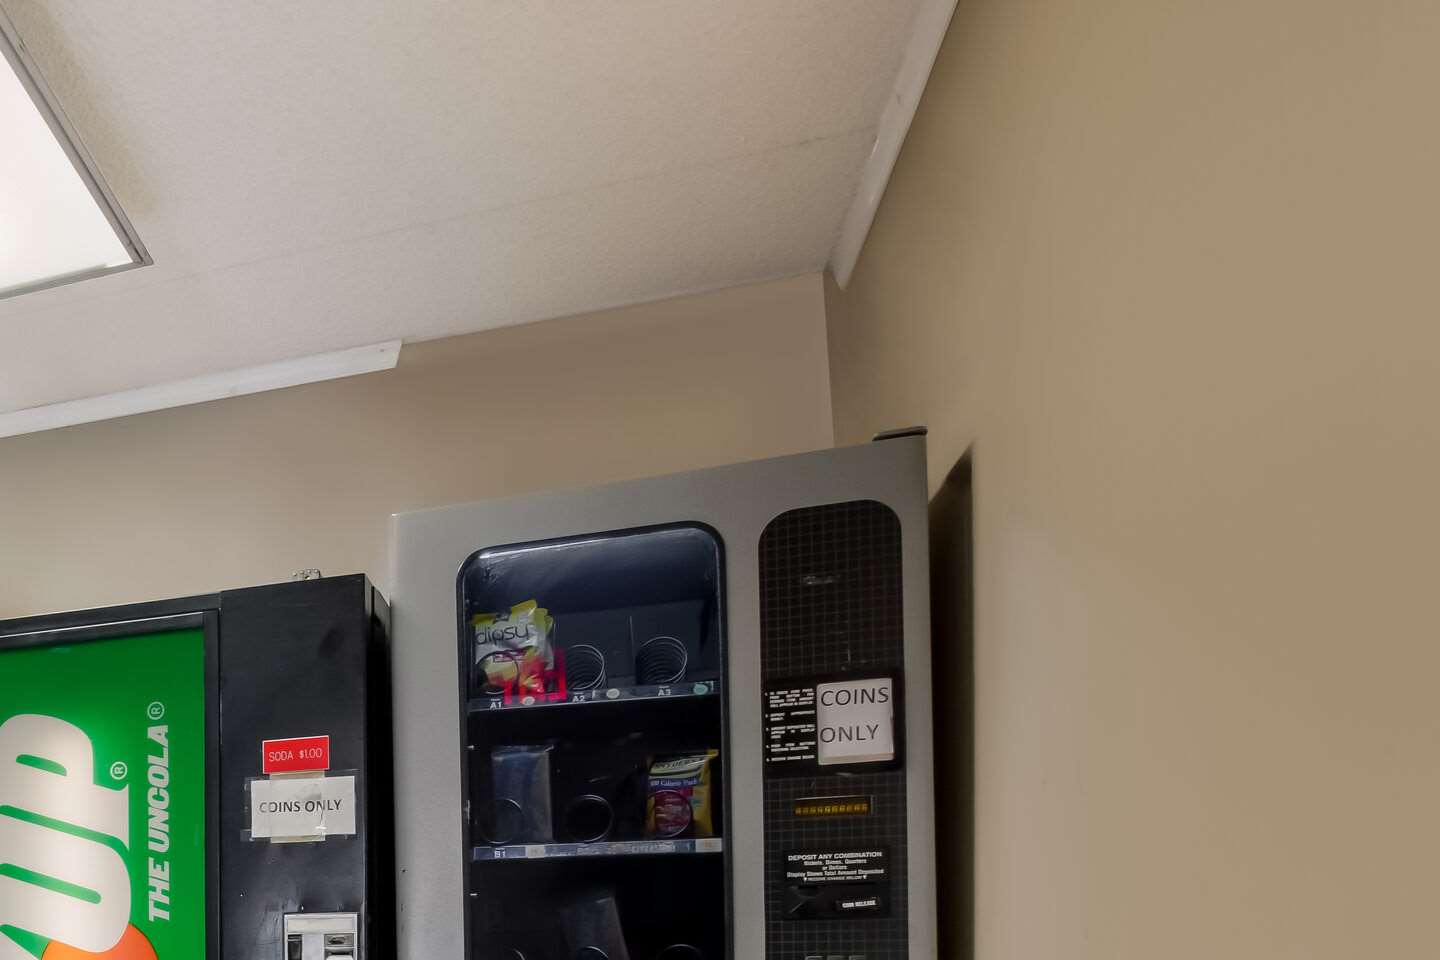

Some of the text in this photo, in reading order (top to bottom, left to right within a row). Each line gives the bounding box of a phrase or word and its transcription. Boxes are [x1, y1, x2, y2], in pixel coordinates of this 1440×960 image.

[657, 688, 672, 697] A3
[820, 687, 890, 707] COINS
[820, 724, 880, 743] ONLY
[268, 751, 294, 762] SODA
[259, 798, 343, 814] COINS ONLY
[787, 854, 817, 862] DEPOSIT
[148, 855, 171, 922] THE
